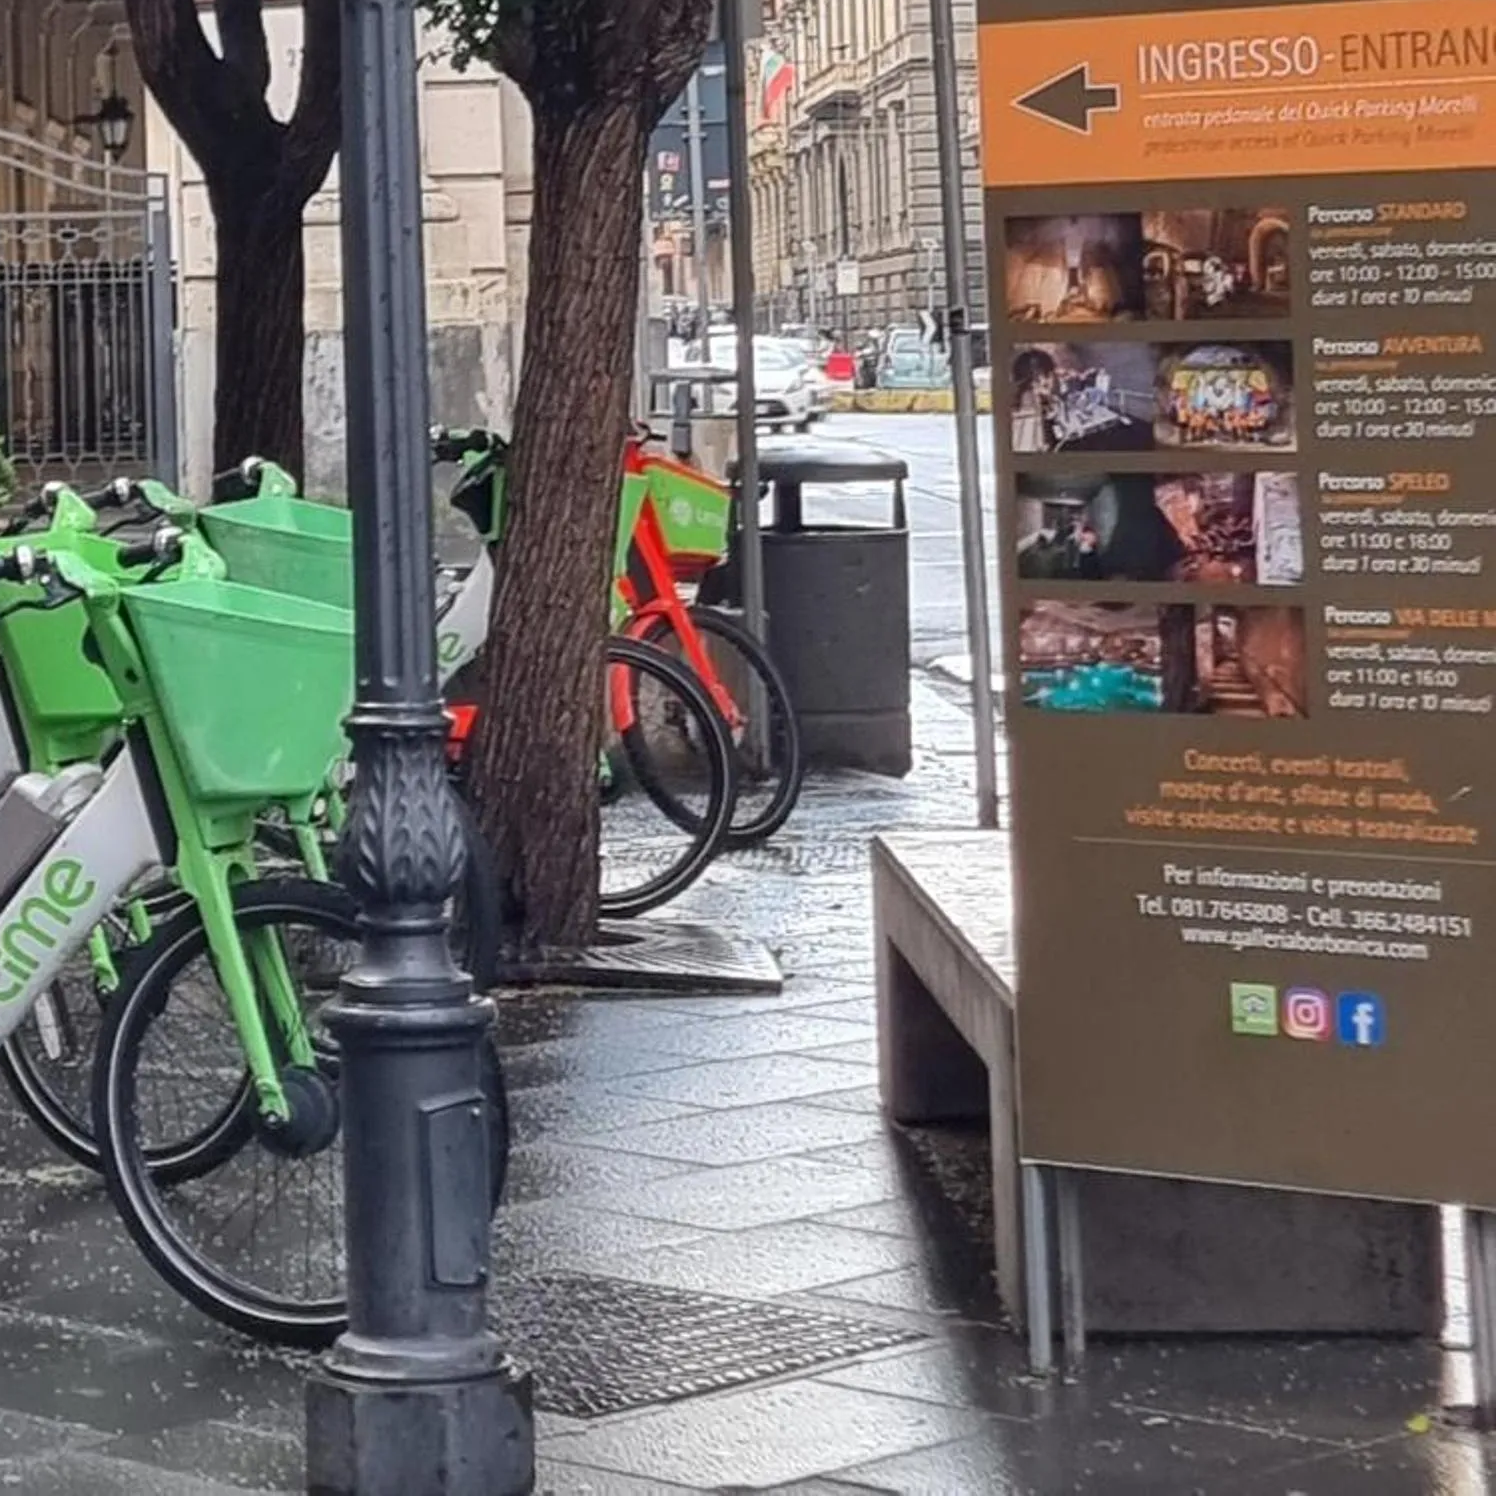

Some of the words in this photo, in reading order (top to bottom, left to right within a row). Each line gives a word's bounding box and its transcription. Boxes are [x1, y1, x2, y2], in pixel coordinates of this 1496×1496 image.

[1138, 35, 1319, 84] INGRESSO
[1340, 25, 1496, 73] ENTRAN
[1278, 101, 1304, 122] del
[1306, 99, 1349, 121] Quick
[1355, 97, 1416, 122] Parking
[1308, 205, 1373, 223] Percorso
[1377, 201, 1467, 221] STANDARD
[1310, 268, 1335, 282] ore
[1339, 266, 1380, 282] 10:00
[1397, 264, 1438, 280] 12:00
[1312, 289, 1347, 305] dura
[1360, 292, 1386, 305] ora
[1404, 287, 1420, 304] 10
[1423, 284, 1474, 303] minuti
[1312, 338, 1379, 355] Percorso
[1382, 336, 1484, 354] AVVENTURA
[1315, 400, 1340, 415] ore
[1344, 399, 1385, 415] 10:00
[1404, 398, 1446, 415] 12:00
[1316, 421, 1351, 438] dura
[1365, 424, 1391, 438] ora
[1425, 419, 1475, 438] minuti
[1318, 472, 1385, 490] Percorso
[1320, 534, 1345, 548] ore
[1350, 532, 1392, 549] 11:00
[1322, 556, 1358, 572] dura
[1371, 558, 1397, 572] ora
[1431, 555, 1483, 574] minuti
[1324, 606, 1391, 625] Percorso
[1327, 670, 1352, 684] ore
[1356, 668, 1398, 685] 11:00
[1329, 690, 1365, 708] dura
[1378, 695, 1405, 709] ora
[1440, 693, 1492, 713] minuti
[1184, 748, 1268, 775] Concerti,
[1271, 755, 1329, 776] eventi
[1335, 758, 1410, 783] teatrali,
[1159, 781, 1225, 802] mostre
[1290, 783, 1350, 807] sfilate
[1355, 786, 1373, 808] di
[1378, 790, 1439, 814] moda,
[1124, 804, 1175, 826] visite
[1177, 808, 1281, 834] scolastiche
[1284, 817, 1297, 835] e
[1300, 813, 1352, 838] visite
[1356, 817, 1479, 845] teatralizzate
[1163, 863, 1194, 886] Per
[1196, 865, 1308, 892] informazioni
[1311, 877, 1325, 894] e
[1327, 877, 1442, 901] prenotazioni
[1136, 894, 1168, 916] Tel.
[1306, 905, 1349, 928] Cell.
[1181, 927, 1429, 960] www.galleriaborbonica.com
